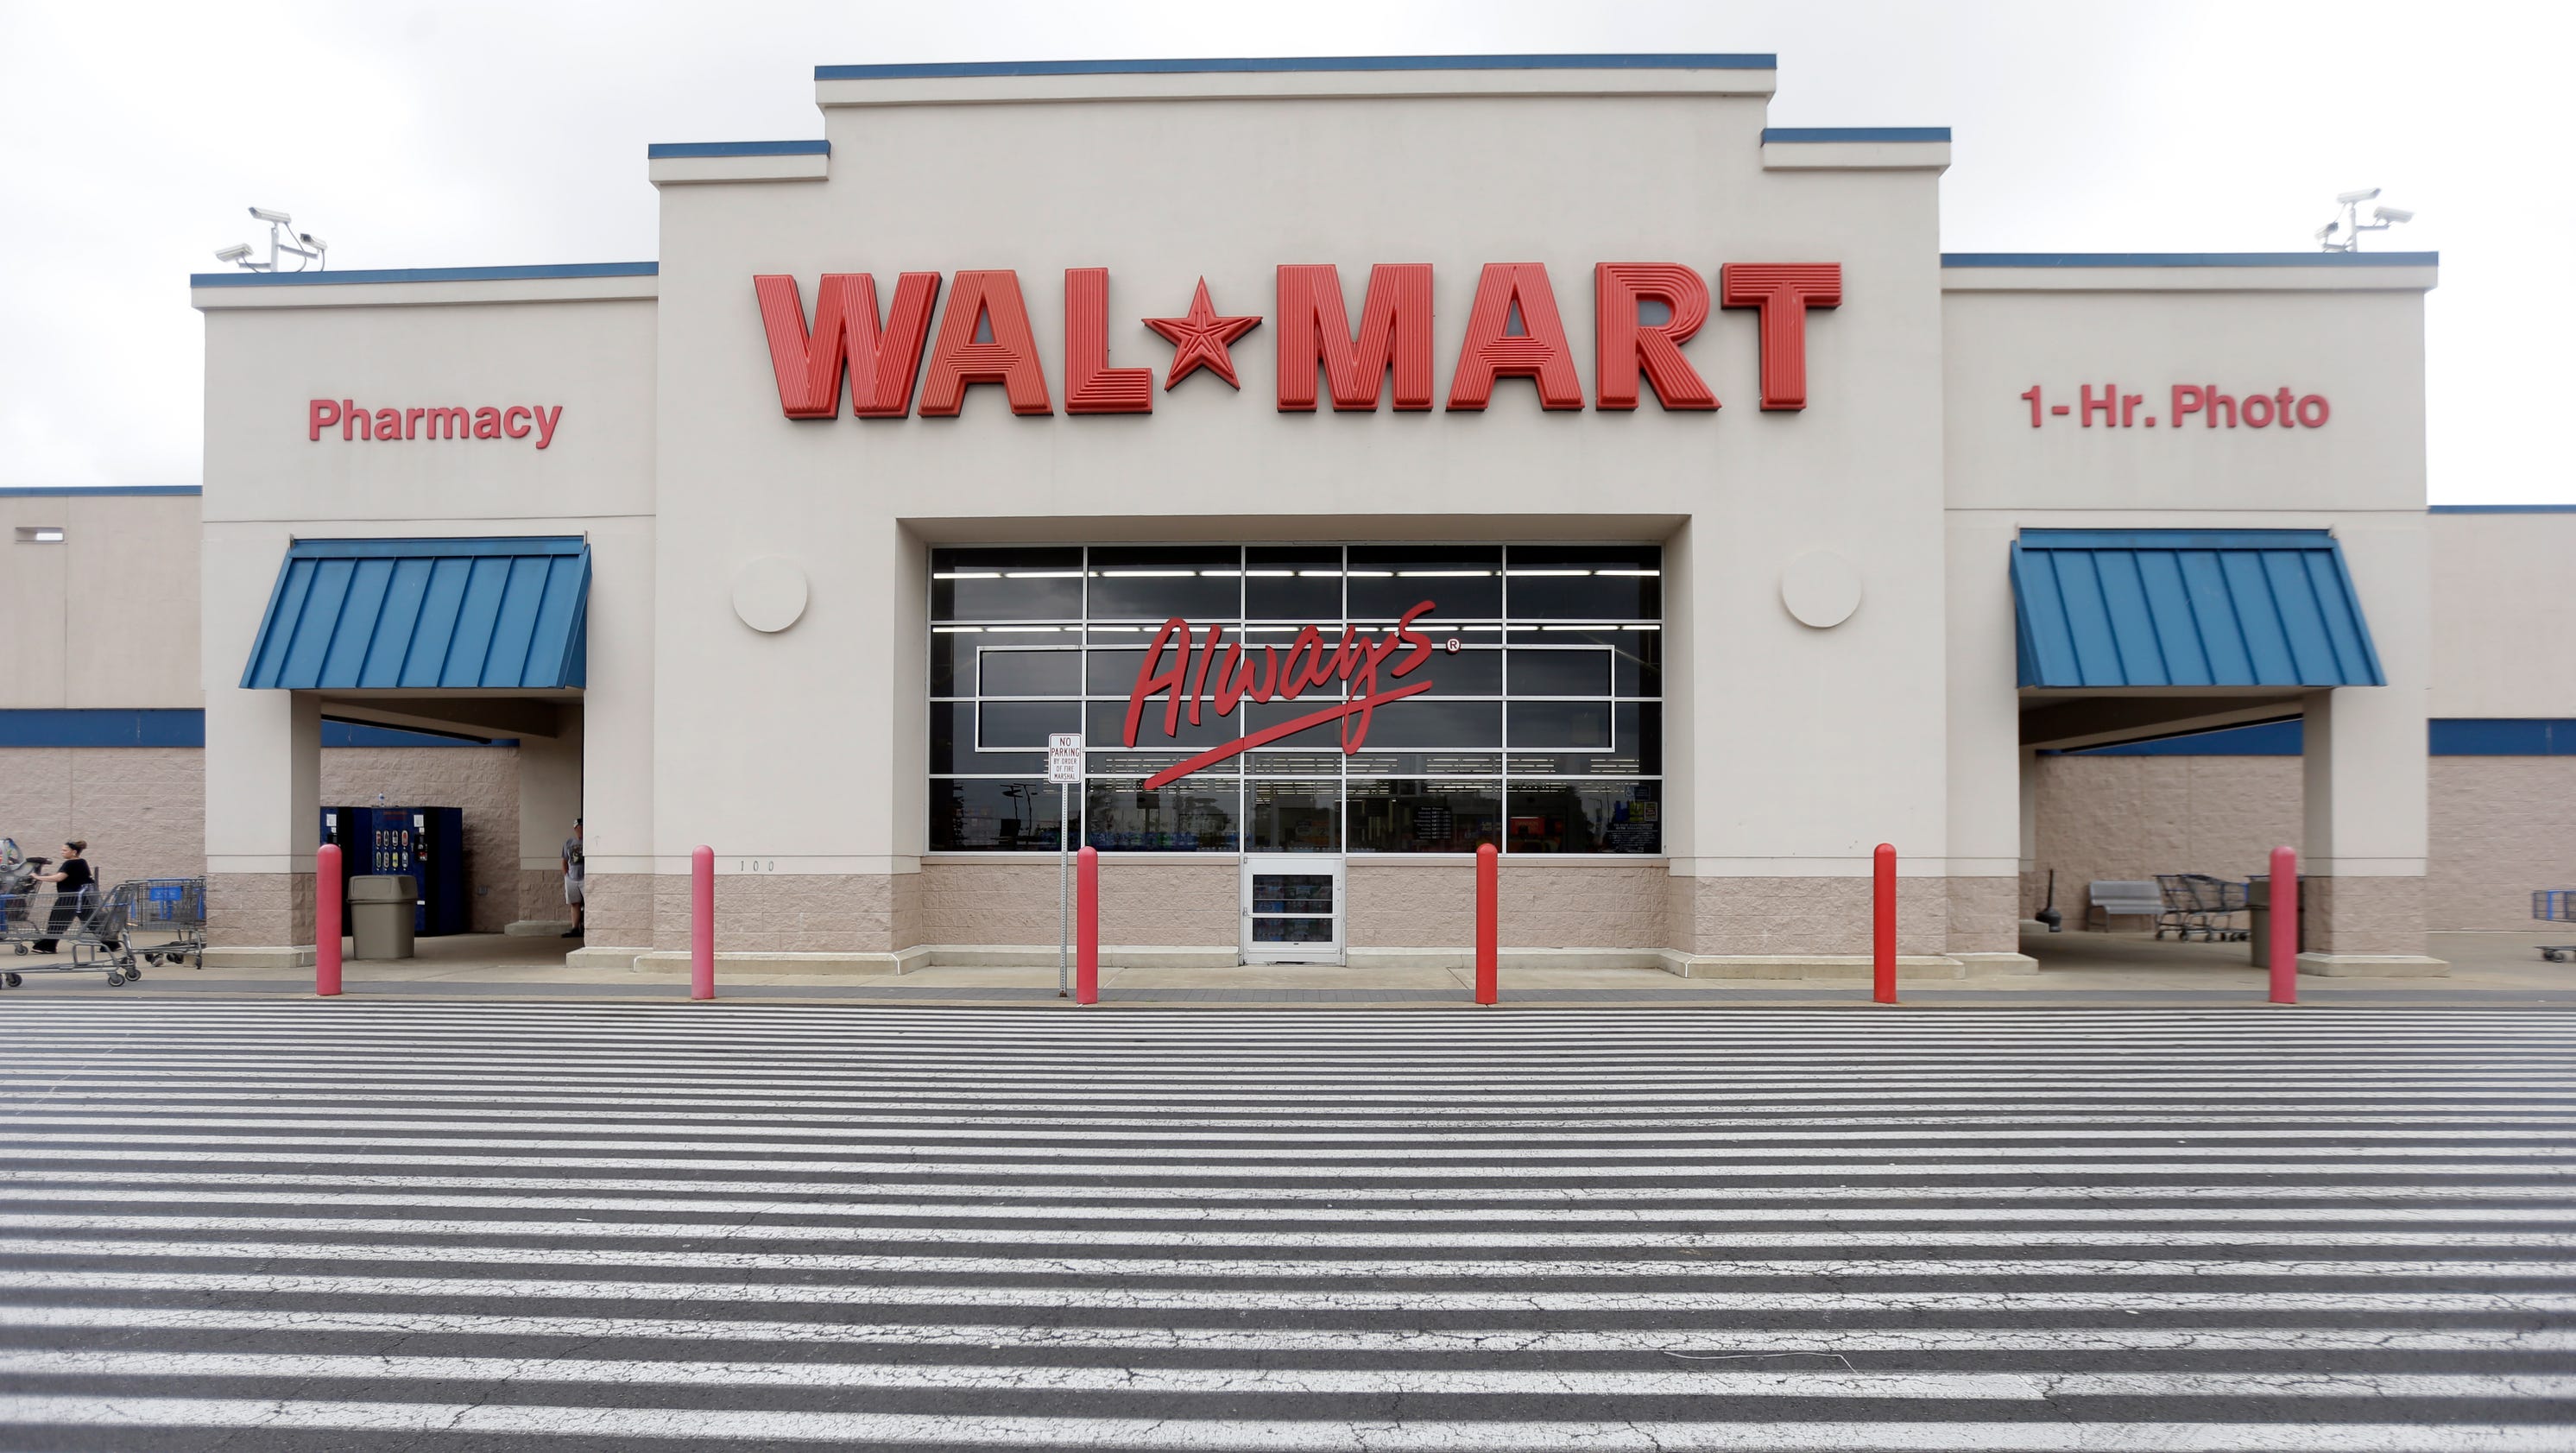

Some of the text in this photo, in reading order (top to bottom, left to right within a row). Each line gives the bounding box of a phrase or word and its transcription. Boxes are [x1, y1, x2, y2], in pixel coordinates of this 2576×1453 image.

[2021, 383, 2330, 429] 1-Hr. Photo
[309, 399, 563, 449] Pharmacy
[1123, 600, 1436, 755] Always
[1051, 748, 1080, 757] PARKING
[1059, 737, 1071, 747] NO
[741, 860, 774, 872] 100
